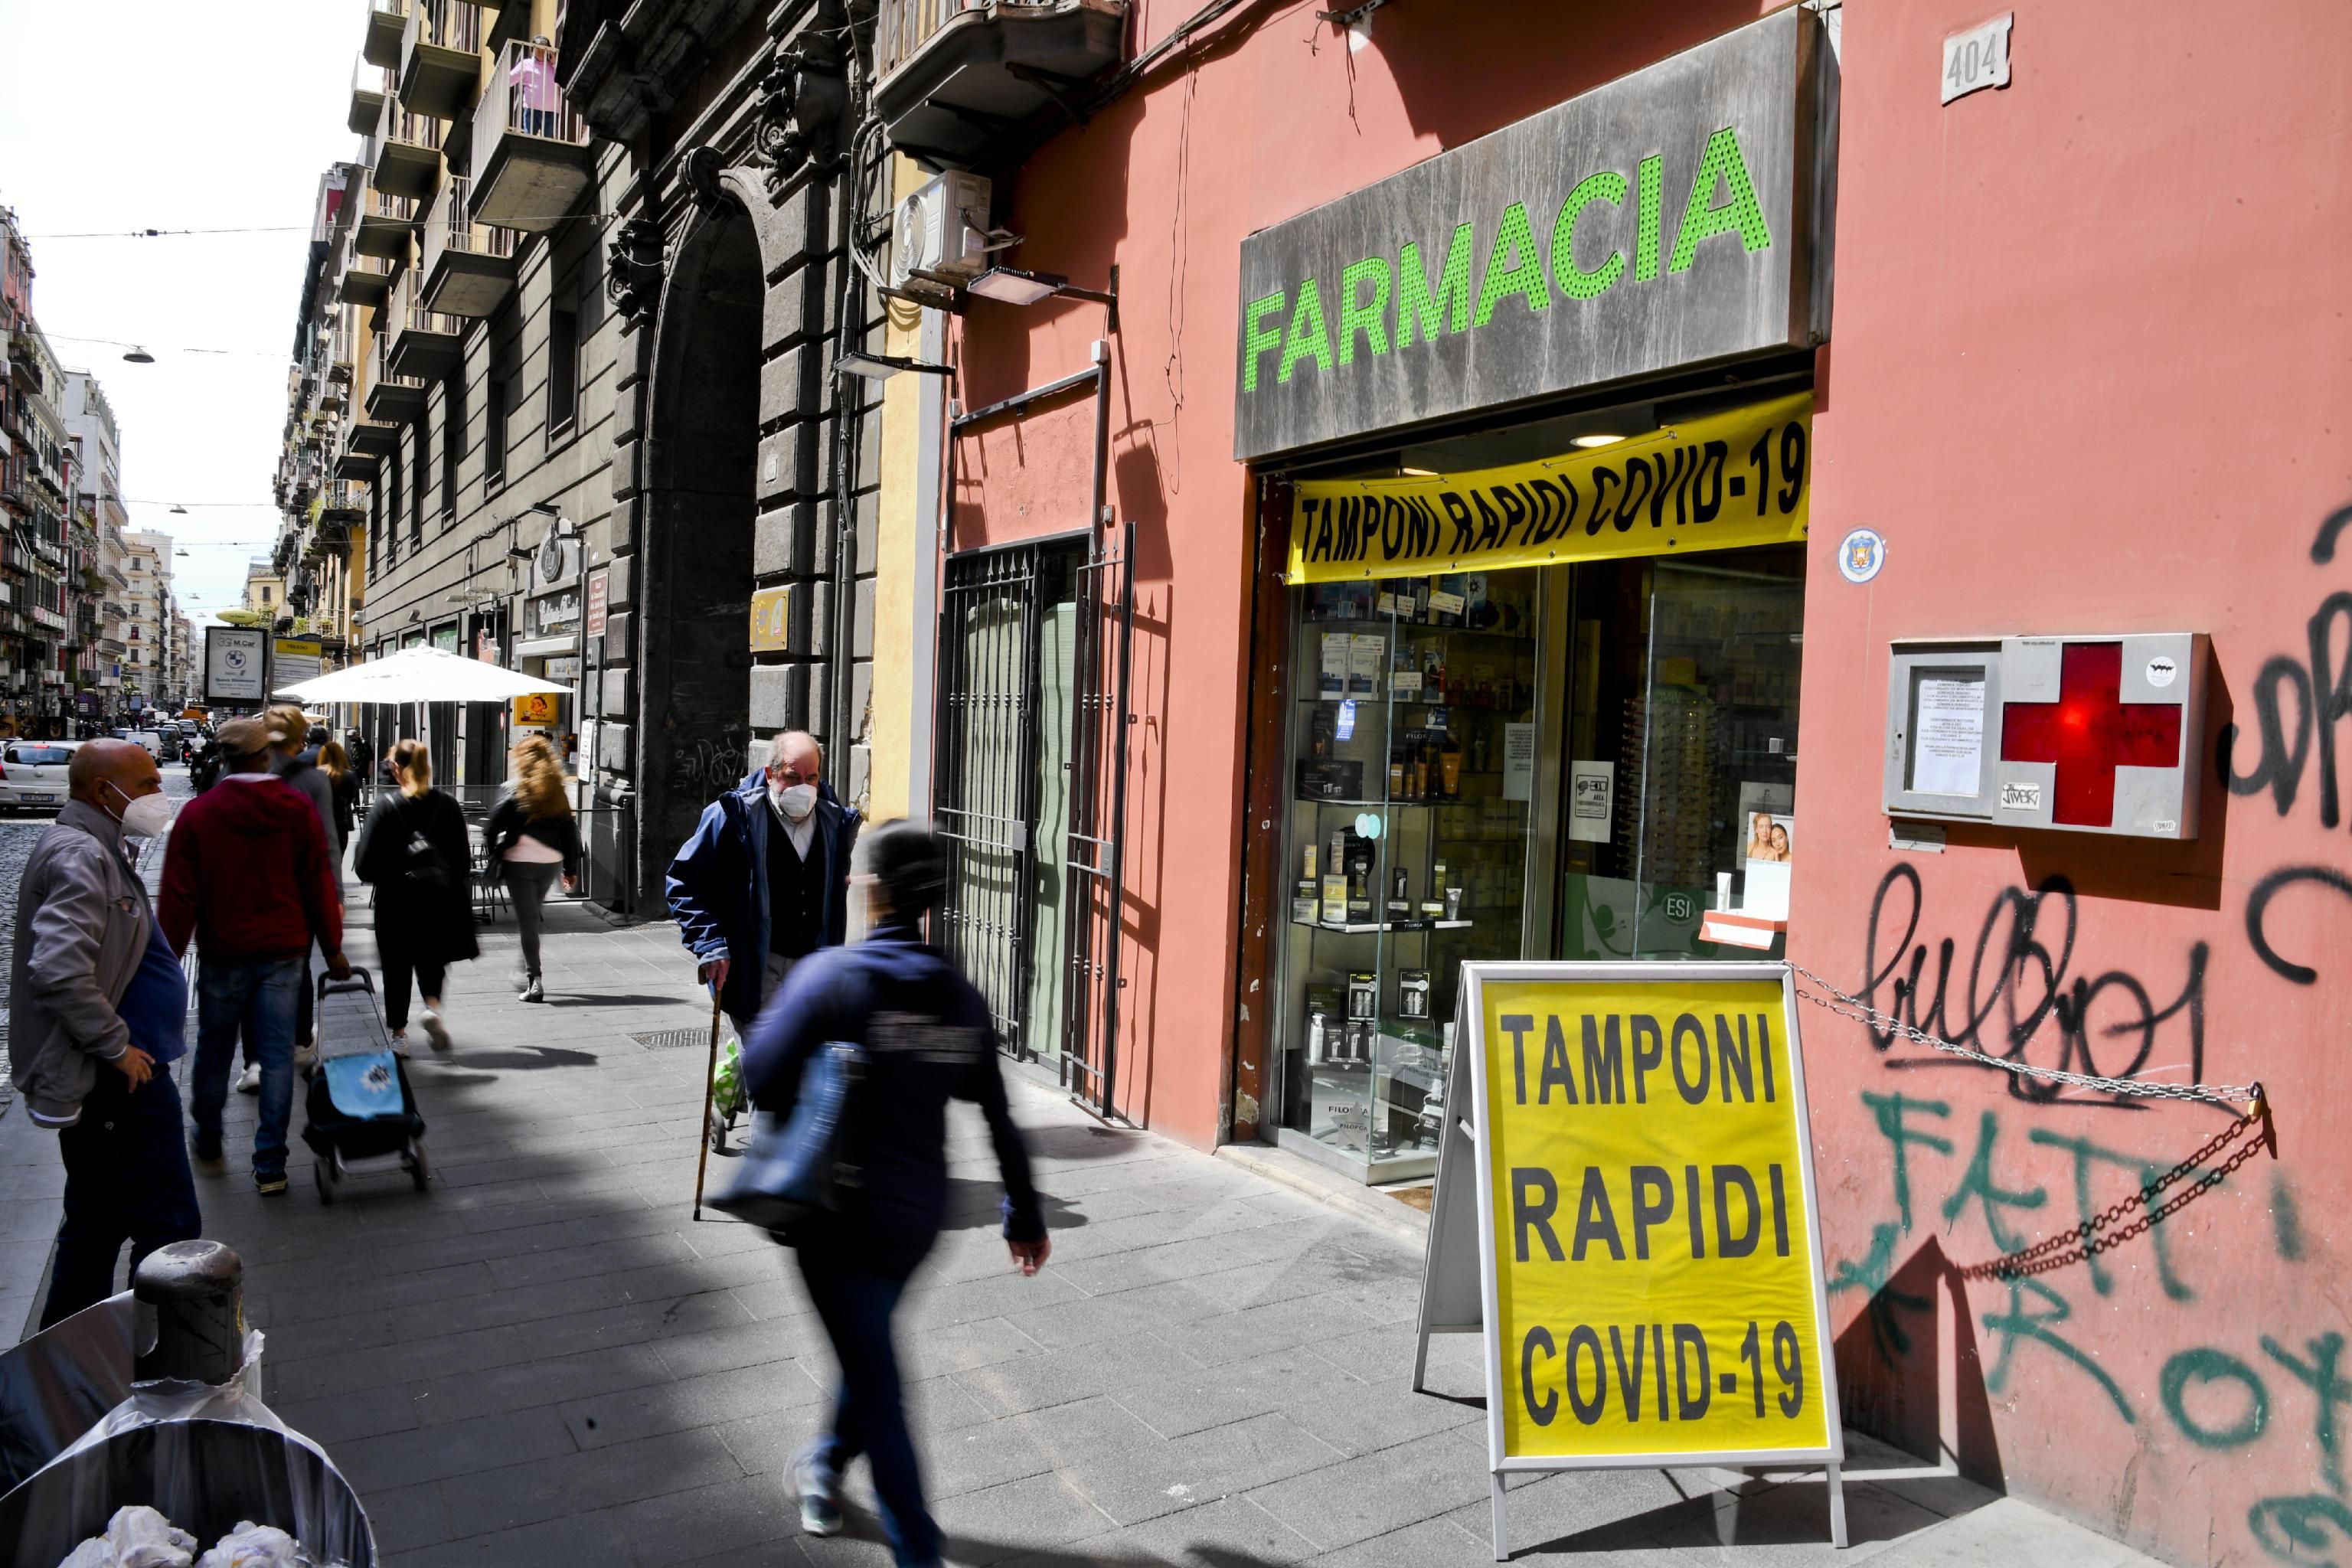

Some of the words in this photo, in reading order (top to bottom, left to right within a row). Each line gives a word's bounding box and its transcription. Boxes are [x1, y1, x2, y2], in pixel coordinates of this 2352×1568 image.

[1947, 34, 1997, 87] 404
[1243, 126, 1771, 394] FARMACIA
[1302, 494, 1441, 564] TAMPONI
[1440, 473, 1579, 555] RAPIDI
[1586, 420, 1807, 535] COVID-19
[1667, 897, 1690, 919] ESI
[1501, 1013, 1776, 1106] TAMPONI
[1510, 1163, 1790, 1263] RAPIDI
[1521, 1320, 1804, 1427] COVID-19
